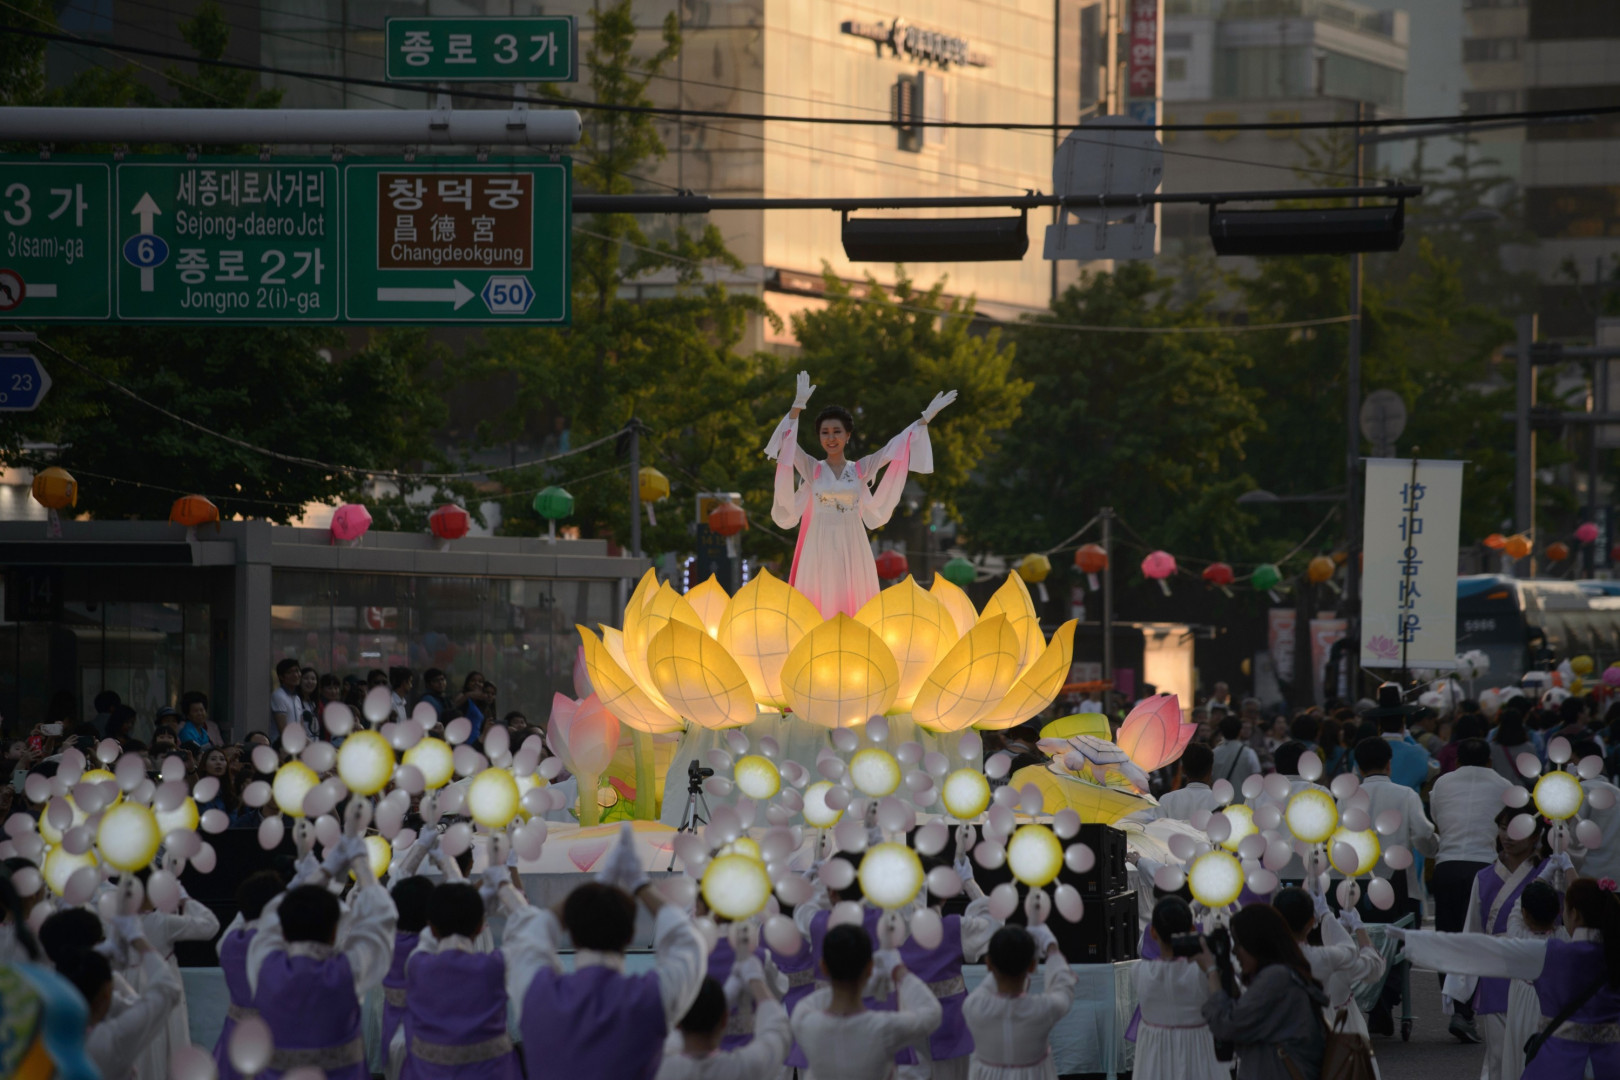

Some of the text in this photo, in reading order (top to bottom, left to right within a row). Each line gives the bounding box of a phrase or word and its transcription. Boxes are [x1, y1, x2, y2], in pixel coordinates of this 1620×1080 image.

[176, 170, 325, 208] 세종대로사거리
[387, 178, 524, 211] 창덕궁
[176, 211, 325, 240] Sejong-daero Jct
[393, 214, 496, 243] 昌德宮
[8, 234, 84, 260] 3(sam)-ga
[137, 239, 155, 264] 6
[390, 243, 524, 266] Changdeokgung
[180, 287, 320, 314] Jongno 2(i)-ga
[492, 284, 524, 306] 50
[11, 373, 33, 392] 23
